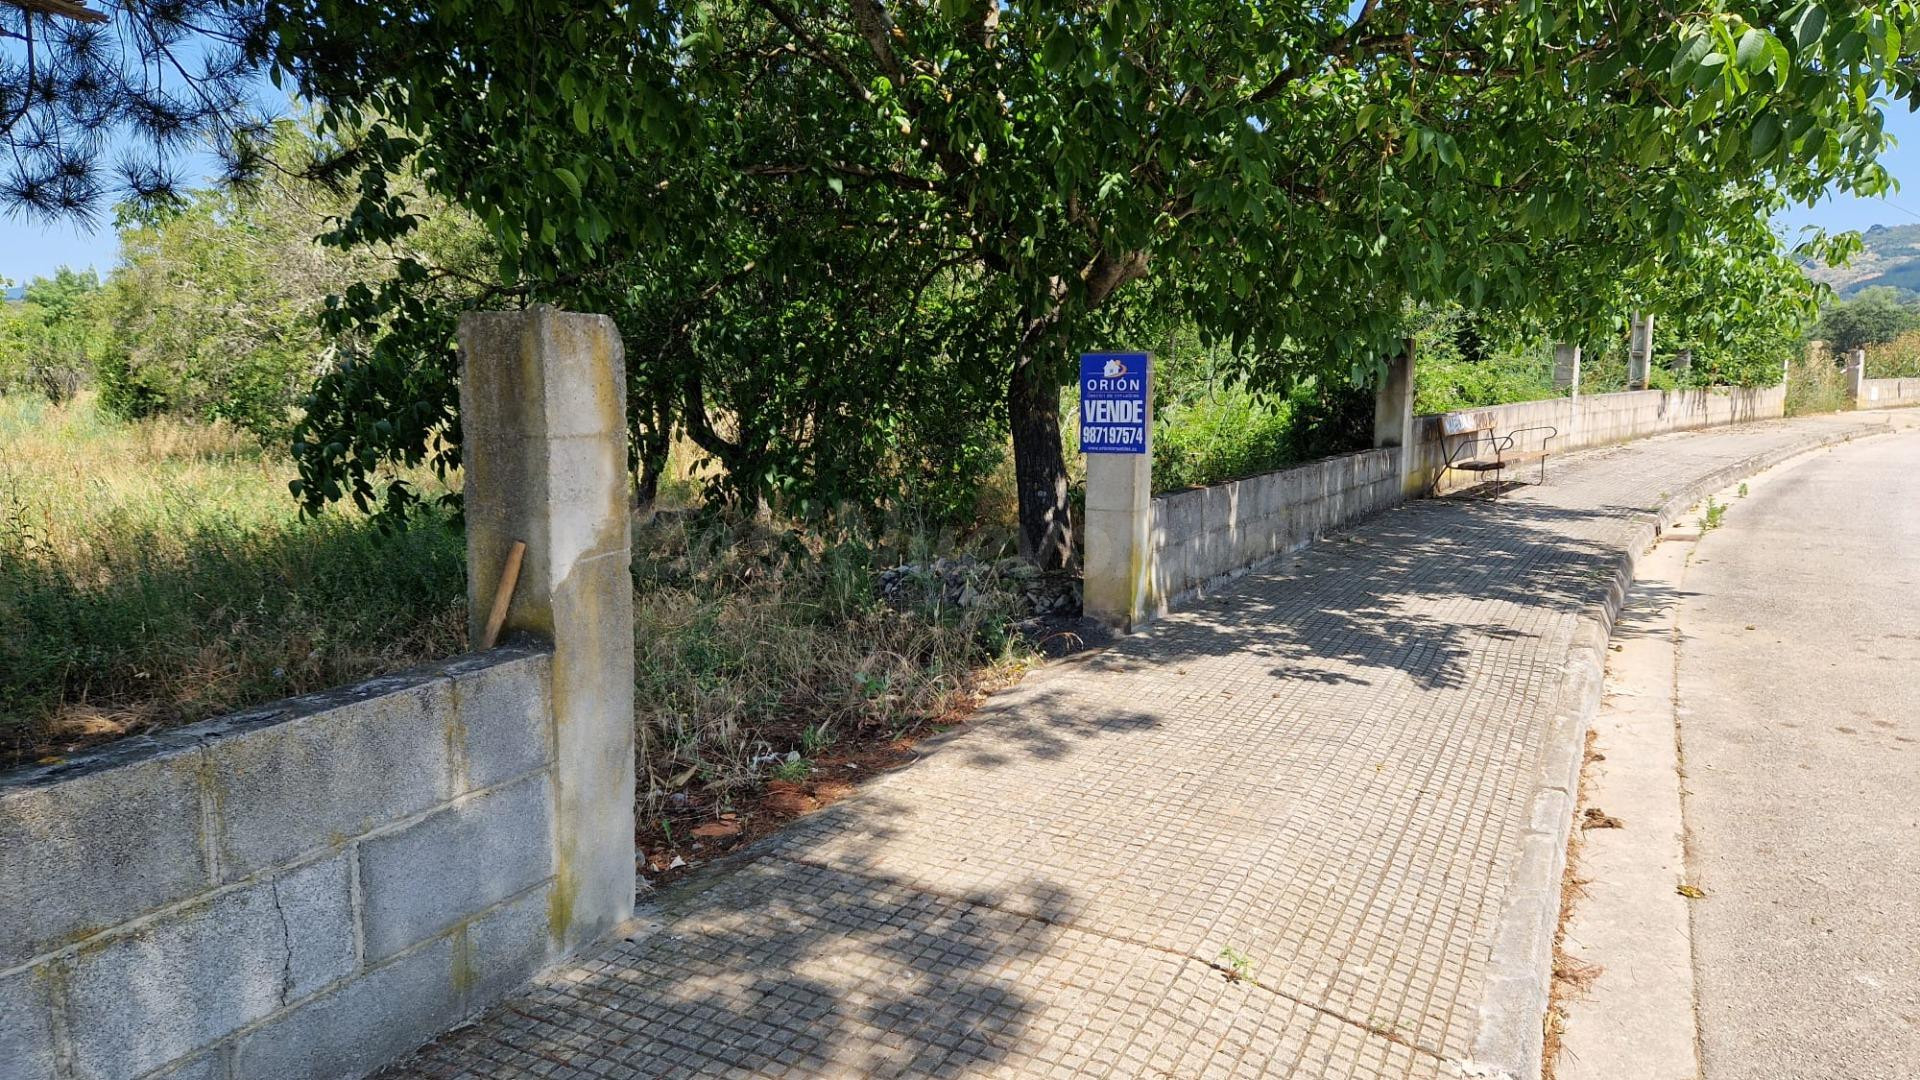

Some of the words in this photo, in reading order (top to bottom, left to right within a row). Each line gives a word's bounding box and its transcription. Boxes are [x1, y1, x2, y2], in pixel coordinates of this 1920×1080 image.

[1087, 377, 1139, 390] ORIÓN
[1084, 400, 1143, 423] VENDE
[1083, 426, 1143, 444] 987197574
